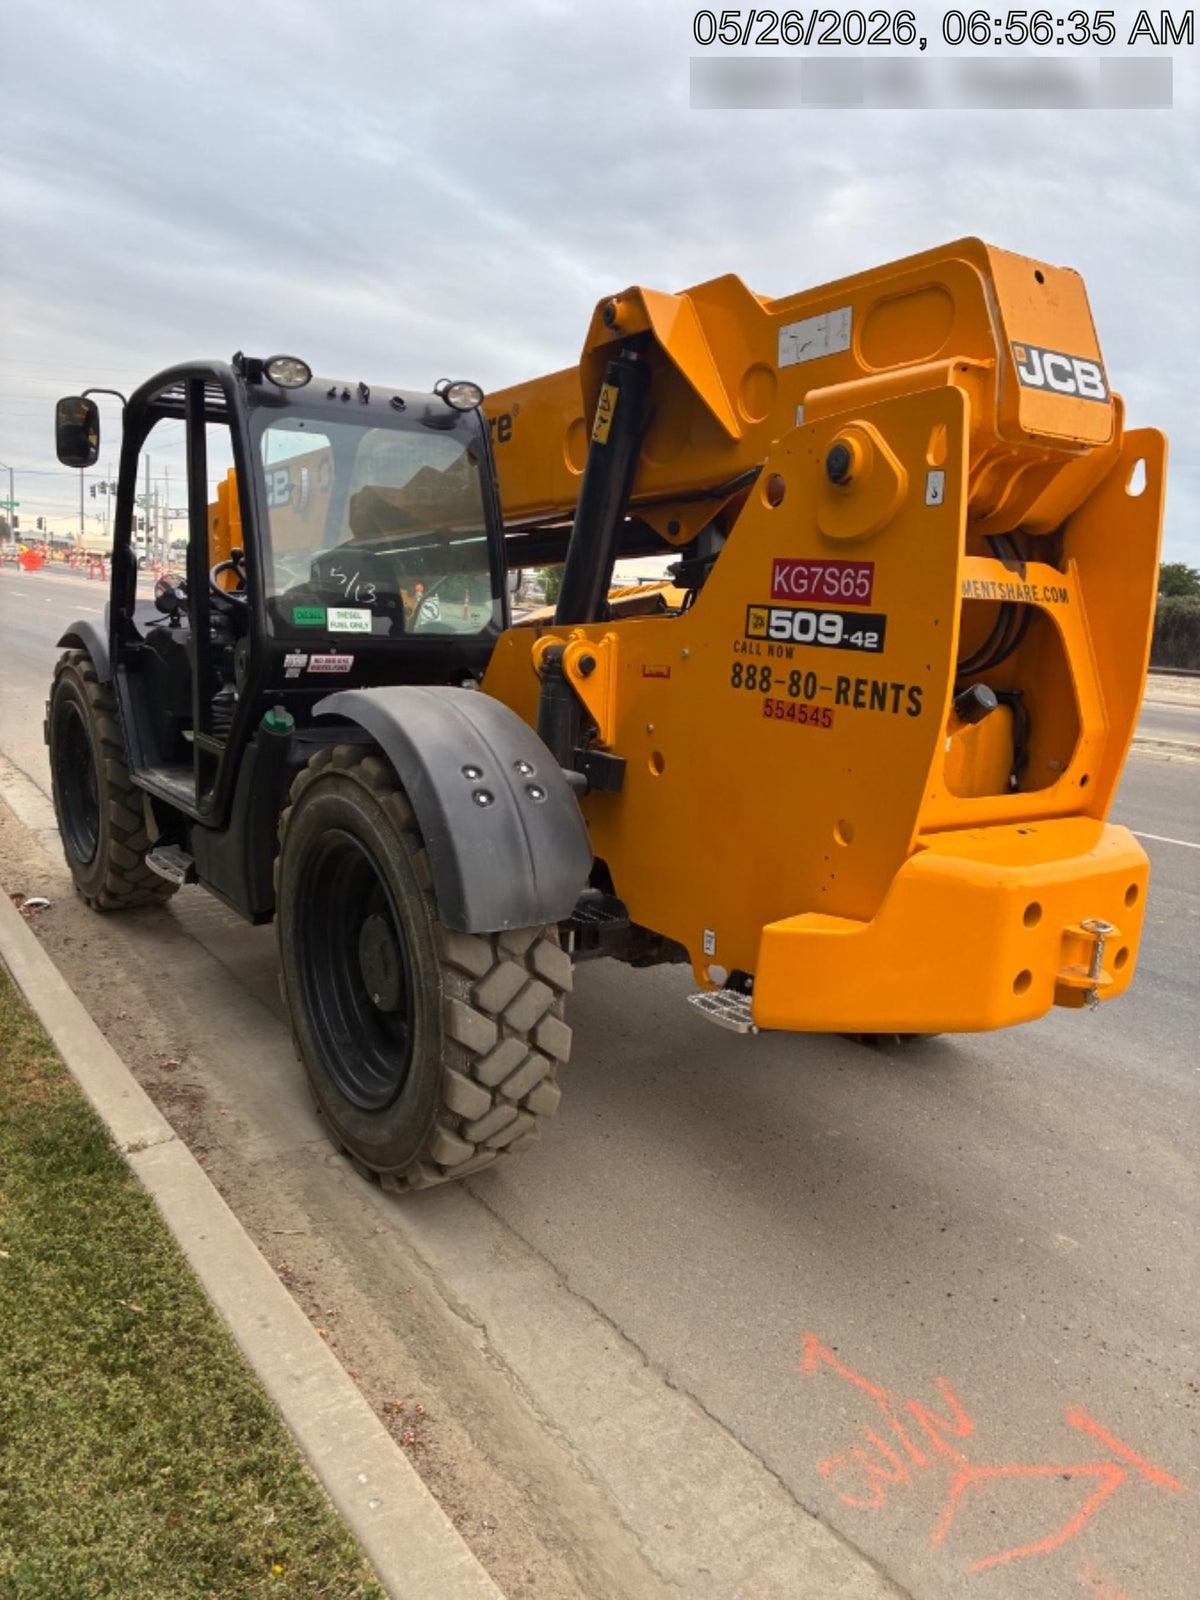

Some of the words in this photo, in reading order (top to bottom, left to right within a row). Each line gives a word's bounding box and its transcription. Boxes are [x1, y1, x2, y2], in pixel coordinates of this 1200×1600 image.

[1018, 349, 1106, 399] JCB
[773, 565, 870, 598] KG7S65
[733, 640, 762, 656] CALL
[767, 644, 796, 660] NOW
[730, 661, 924, 718] 888-80-RENTS
[763, 698, 833, 729] 554545
